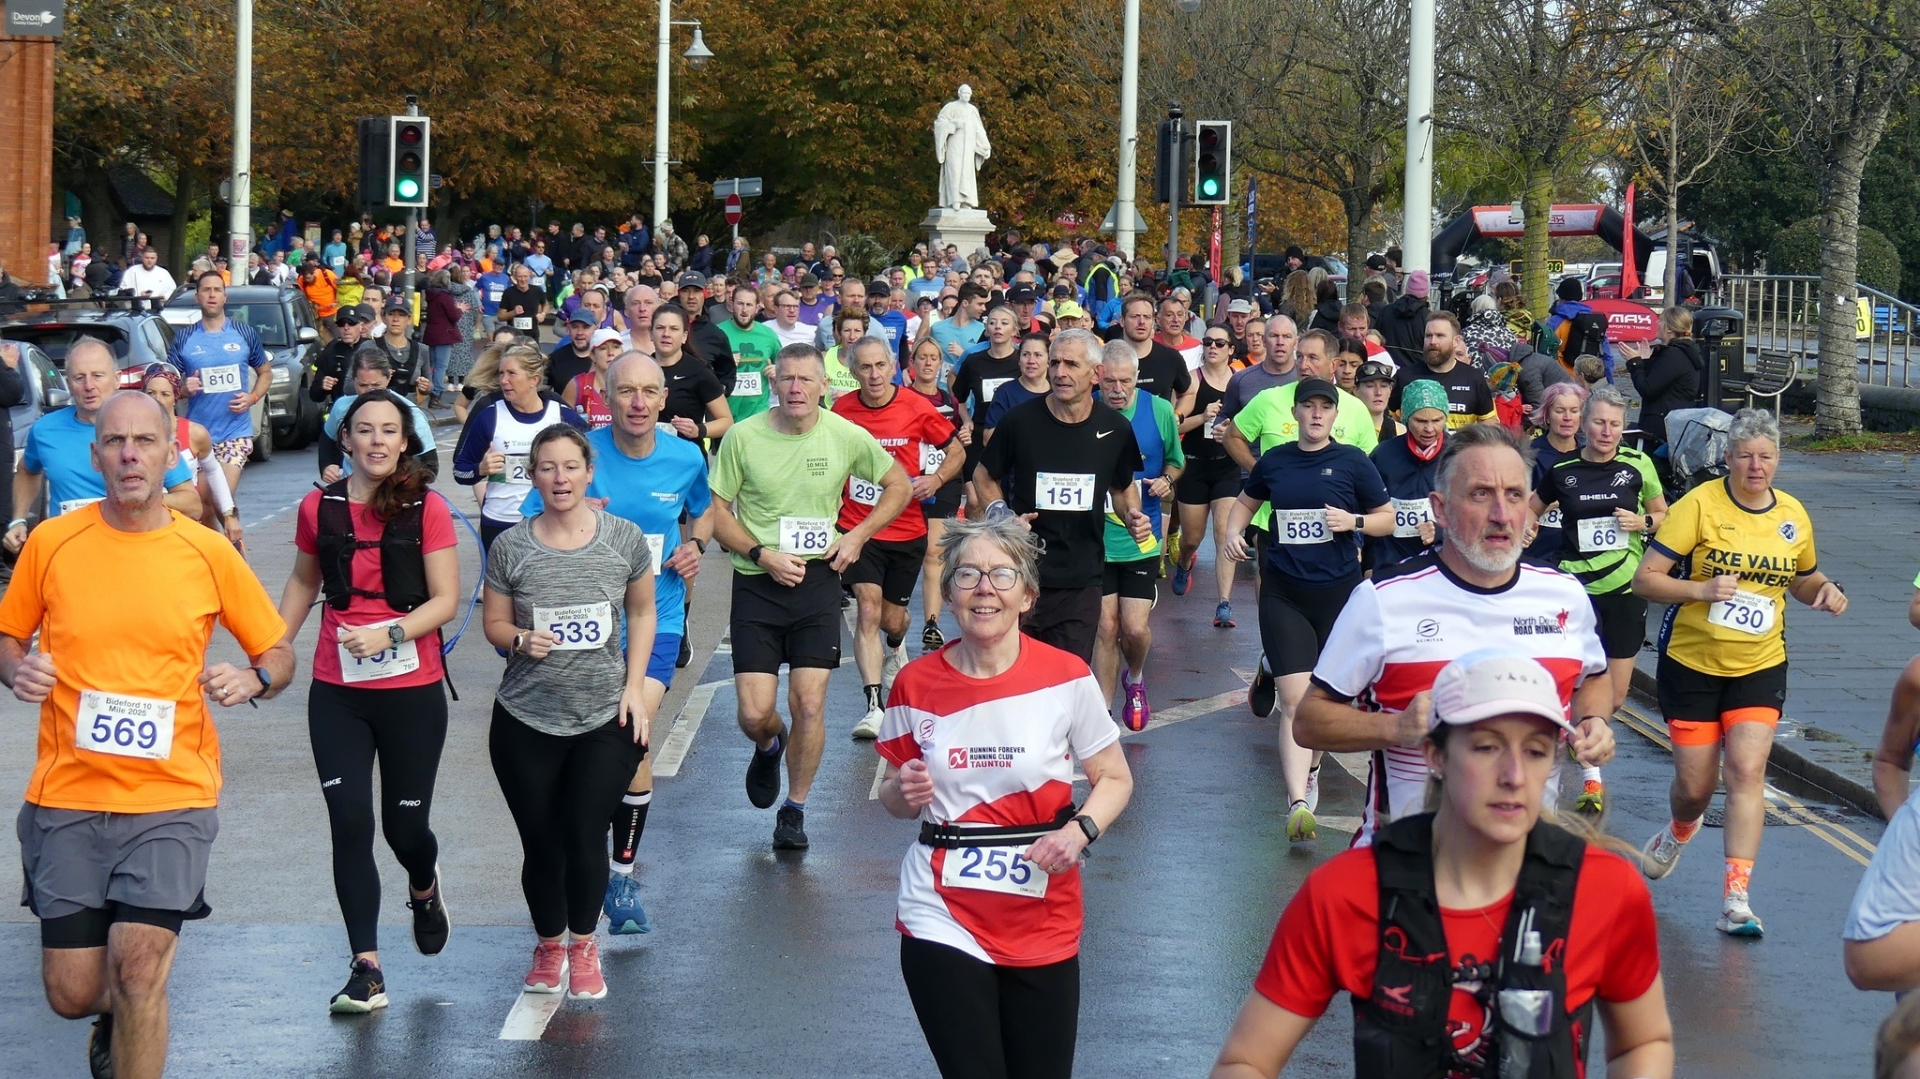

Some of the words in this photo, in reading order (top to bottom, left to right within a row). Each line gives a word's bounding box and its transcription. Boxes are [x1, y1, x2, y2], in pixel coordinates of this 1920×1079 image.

[13, 12, 41, 21] Devon
[1608, 313, 1652, 324] MAX
[209, 373, 235, 386] 810
[1046, 488, 1082, 505] 151
[1579, 493, 1618, 501] SHEILA
[1396, 510, 1429, 527] 661
[1287, 521, 1324, 539] 583
[791, 531, 828, 549] 183
[1593, 529, 1616, 546] 66
[1705, 549, 1741, 567] AXE
[554, 608, 582, 618] Bideford
[558, 613, 572, 621] Mile
[1723, 601, 1764, 629] 730
[1513, 616, 1536, 625] North
[550, 620, 601, 643] 533
[1513, 624, 1533, 635] ROAD
[105, 697, 141, 709] Bideford
[109, 704, 127, 714] Mile
[128, 707, 147, 717] 2025
[91, 713, 158, 750] 569
[969, 746, 997, 754] RUNNING
[969, 760, 1012, 768] TAUNTON
[323, 777, 342, 788] NIKE
[399, 799, 422, 807] PRO
[959, 847, 1031, 885] 255
